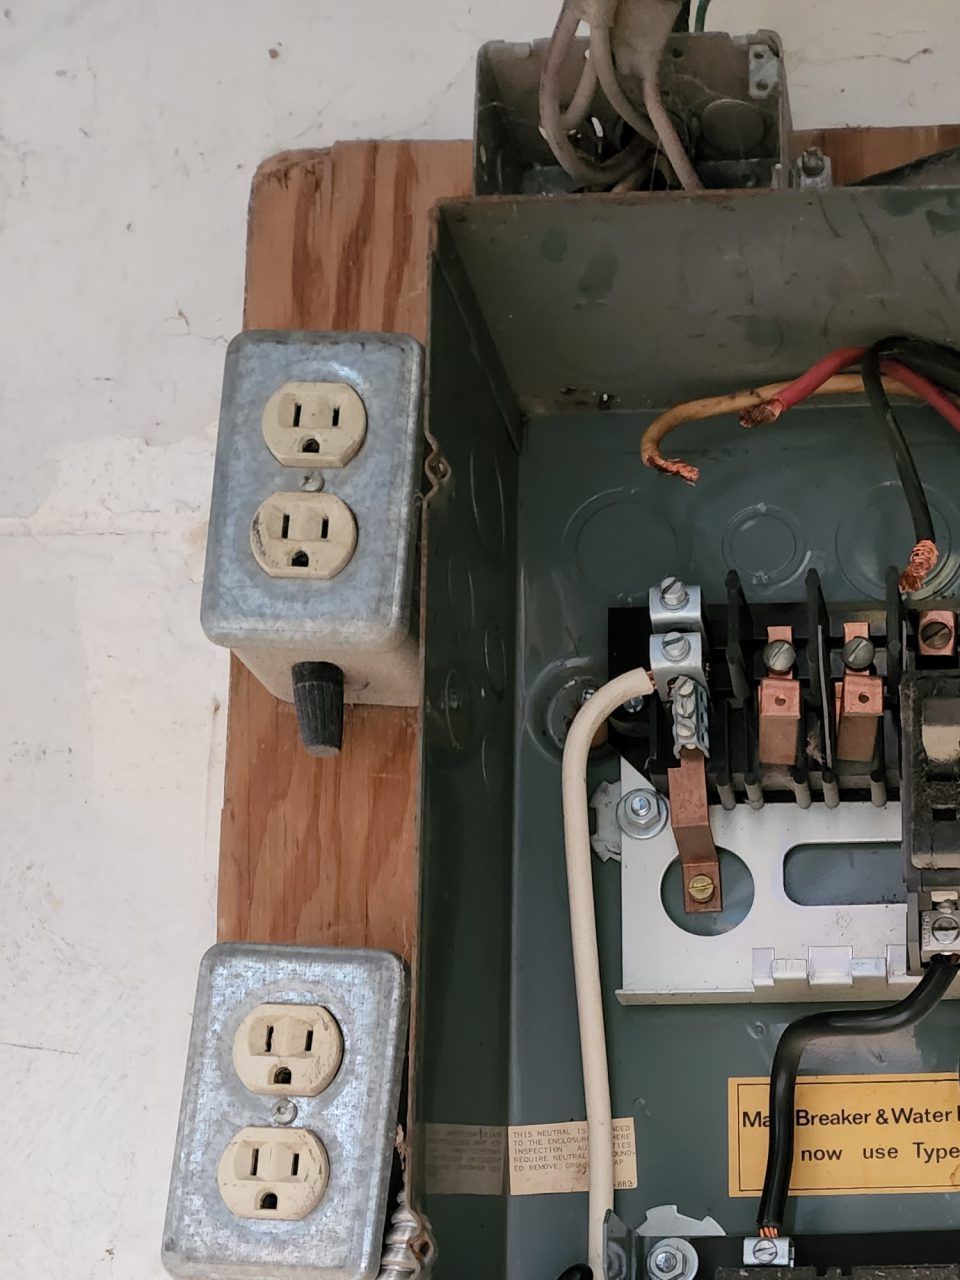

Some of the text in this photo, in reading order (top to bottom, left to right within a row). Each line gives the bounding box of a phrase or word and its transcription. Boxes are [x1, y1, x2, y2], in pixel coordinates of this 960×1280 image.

[742, 1111, 770, 1128] Ma
[795, 1109, 872, 1127] Breaker
[875, 1108, 889, 1125] &
[890, 1107, 953, 1124] Water
[537, 1129, 571, 1137] NEUTRAL
[577, 1127, 586, 1135] IS
[528, 1138, 542, 1146] THE
[547, 1136, 588, 1144] ENCLOSUR
[514, 1147, 563, 1155] INSPECTION
[801, 1148, 843, 1162] now
[862, 1146, 899, 1160] use
[912, 1141, 960, 1164] Type
[513, 1155, 548, 1164] REQUIRE
[553, 1153, 587, 1161] NEUTRAL
